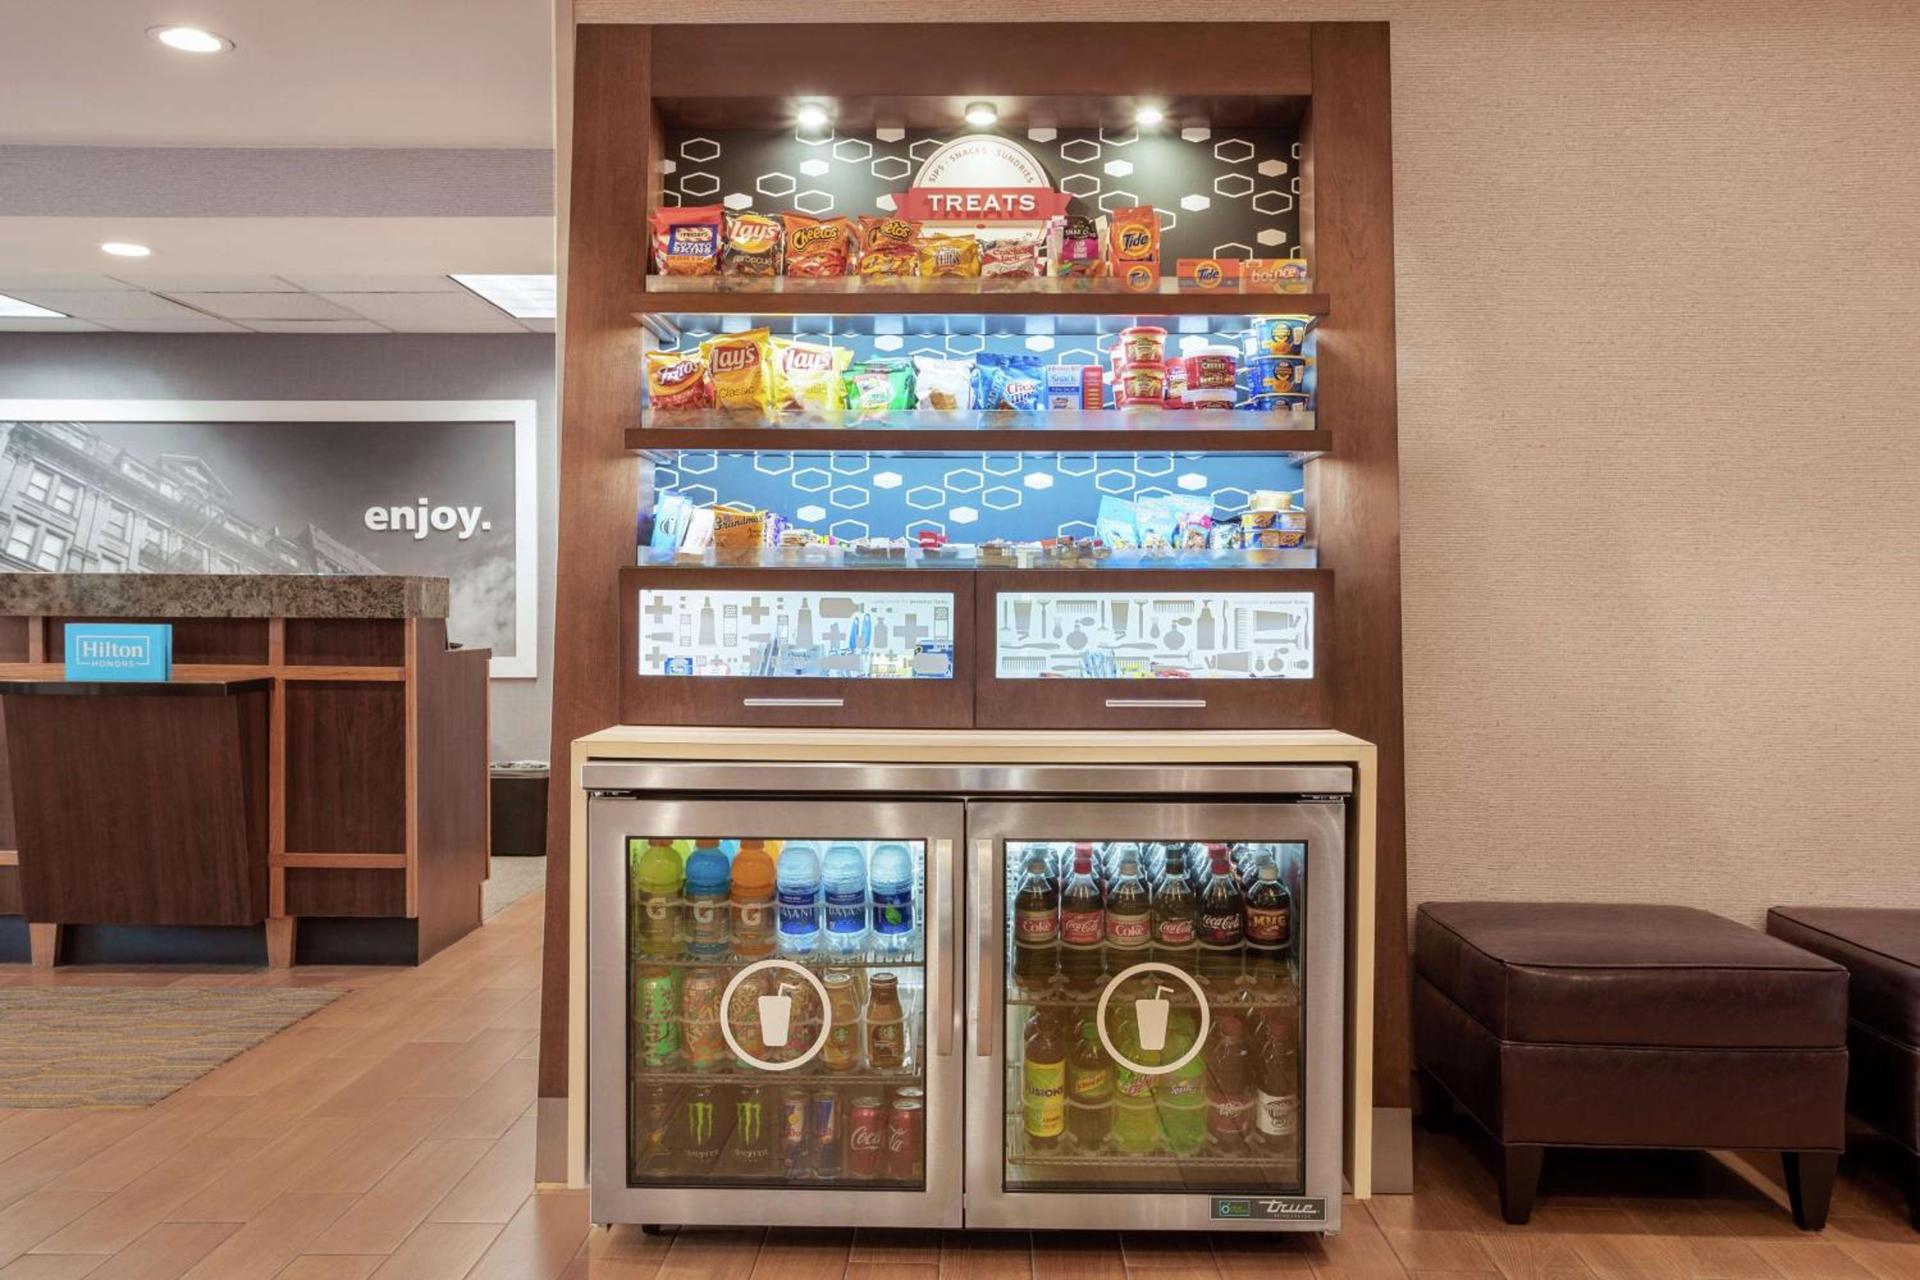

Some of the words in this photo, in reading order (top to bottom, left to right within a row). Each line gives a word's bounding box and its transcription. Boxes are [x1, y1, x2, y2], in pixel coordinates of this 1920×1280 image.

[927, 194, 1036, 212] TREATS
[791, 226, 838, 251] Cheetos
[1123, 232, 1149, 251] Tide
[1129, 271, 1151, 287] Tide
[1198, 267, 1220, 281] Tide
[1251, 267, 1296, 284] bounce
[711, 344, 755, 373] Lay's
[364, 497, 491, 540] enjoy.
[82, 641, 144, 658] Hilton
[91, 660, 135, 668] HONORS
[646, 897, 666, 920] G
[693, 900, 714, 924] G
[741, 903, 761, 926] G
[1023, 920, 1053, 932] Coke
[1065, 920, 1098, 933] Coca-Cola
[1160, 920, 1192, 935] Coca-Cola
[1253, 915, 1286, 927] MUG
[1115, 924, 1146, 937] Coke
